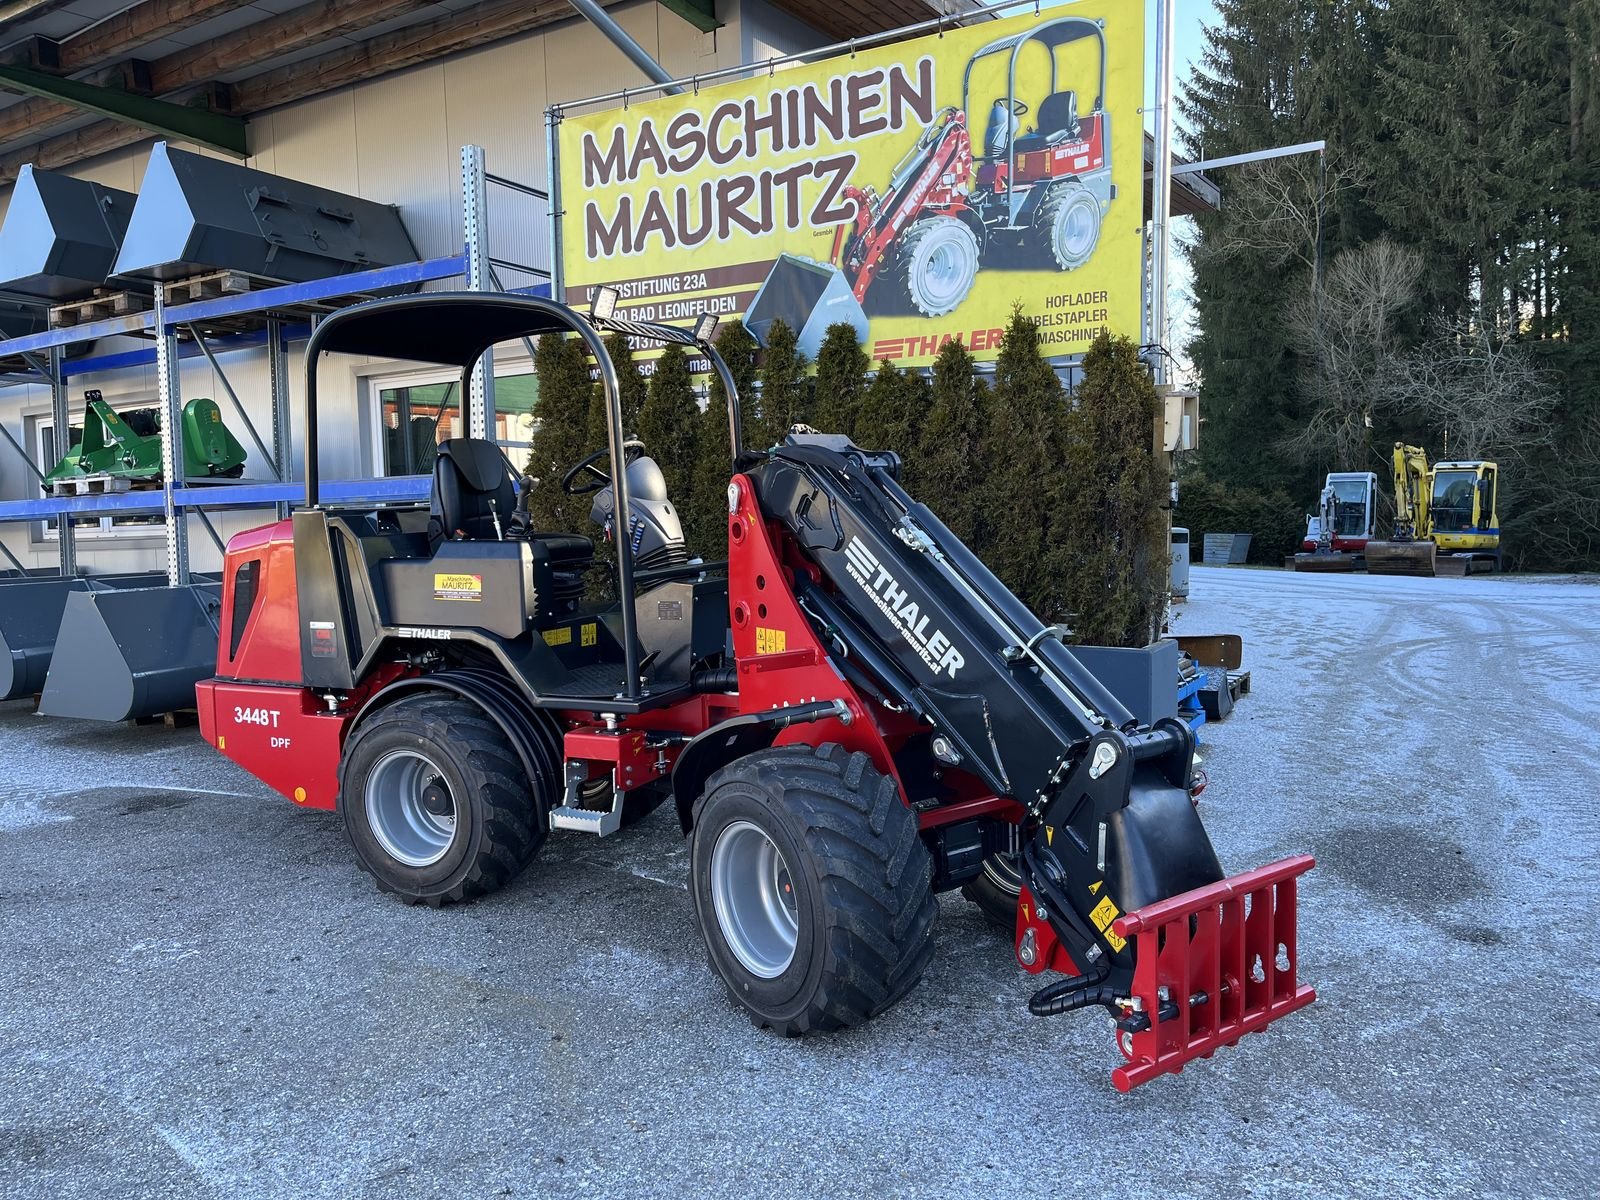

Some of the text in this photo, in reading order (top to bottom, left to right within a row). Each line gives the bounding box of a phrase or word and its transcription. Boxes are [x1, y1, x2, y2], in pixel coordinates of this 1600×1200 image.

[583, 58, 935, 188] MASCHINEN
[585, 154, 856, 259] MAURITZ
[586, 273, 707, 302] URSTIFTUNG 23A
[1045, 290, 1108, 309] HOFLADER
[631, 306, 655, 322] BAD
[658, 296, 737, 319] LEONFELDEN
[1024, 308, 1108, 328] ABELSTAPLER
[845, 561, 943, 676] www.maschinen-mauritz.at
[872, 563, 966, 680] THALER
[410, 627, 452, 640] THALER
[270, 736, 291, 749] DPF
